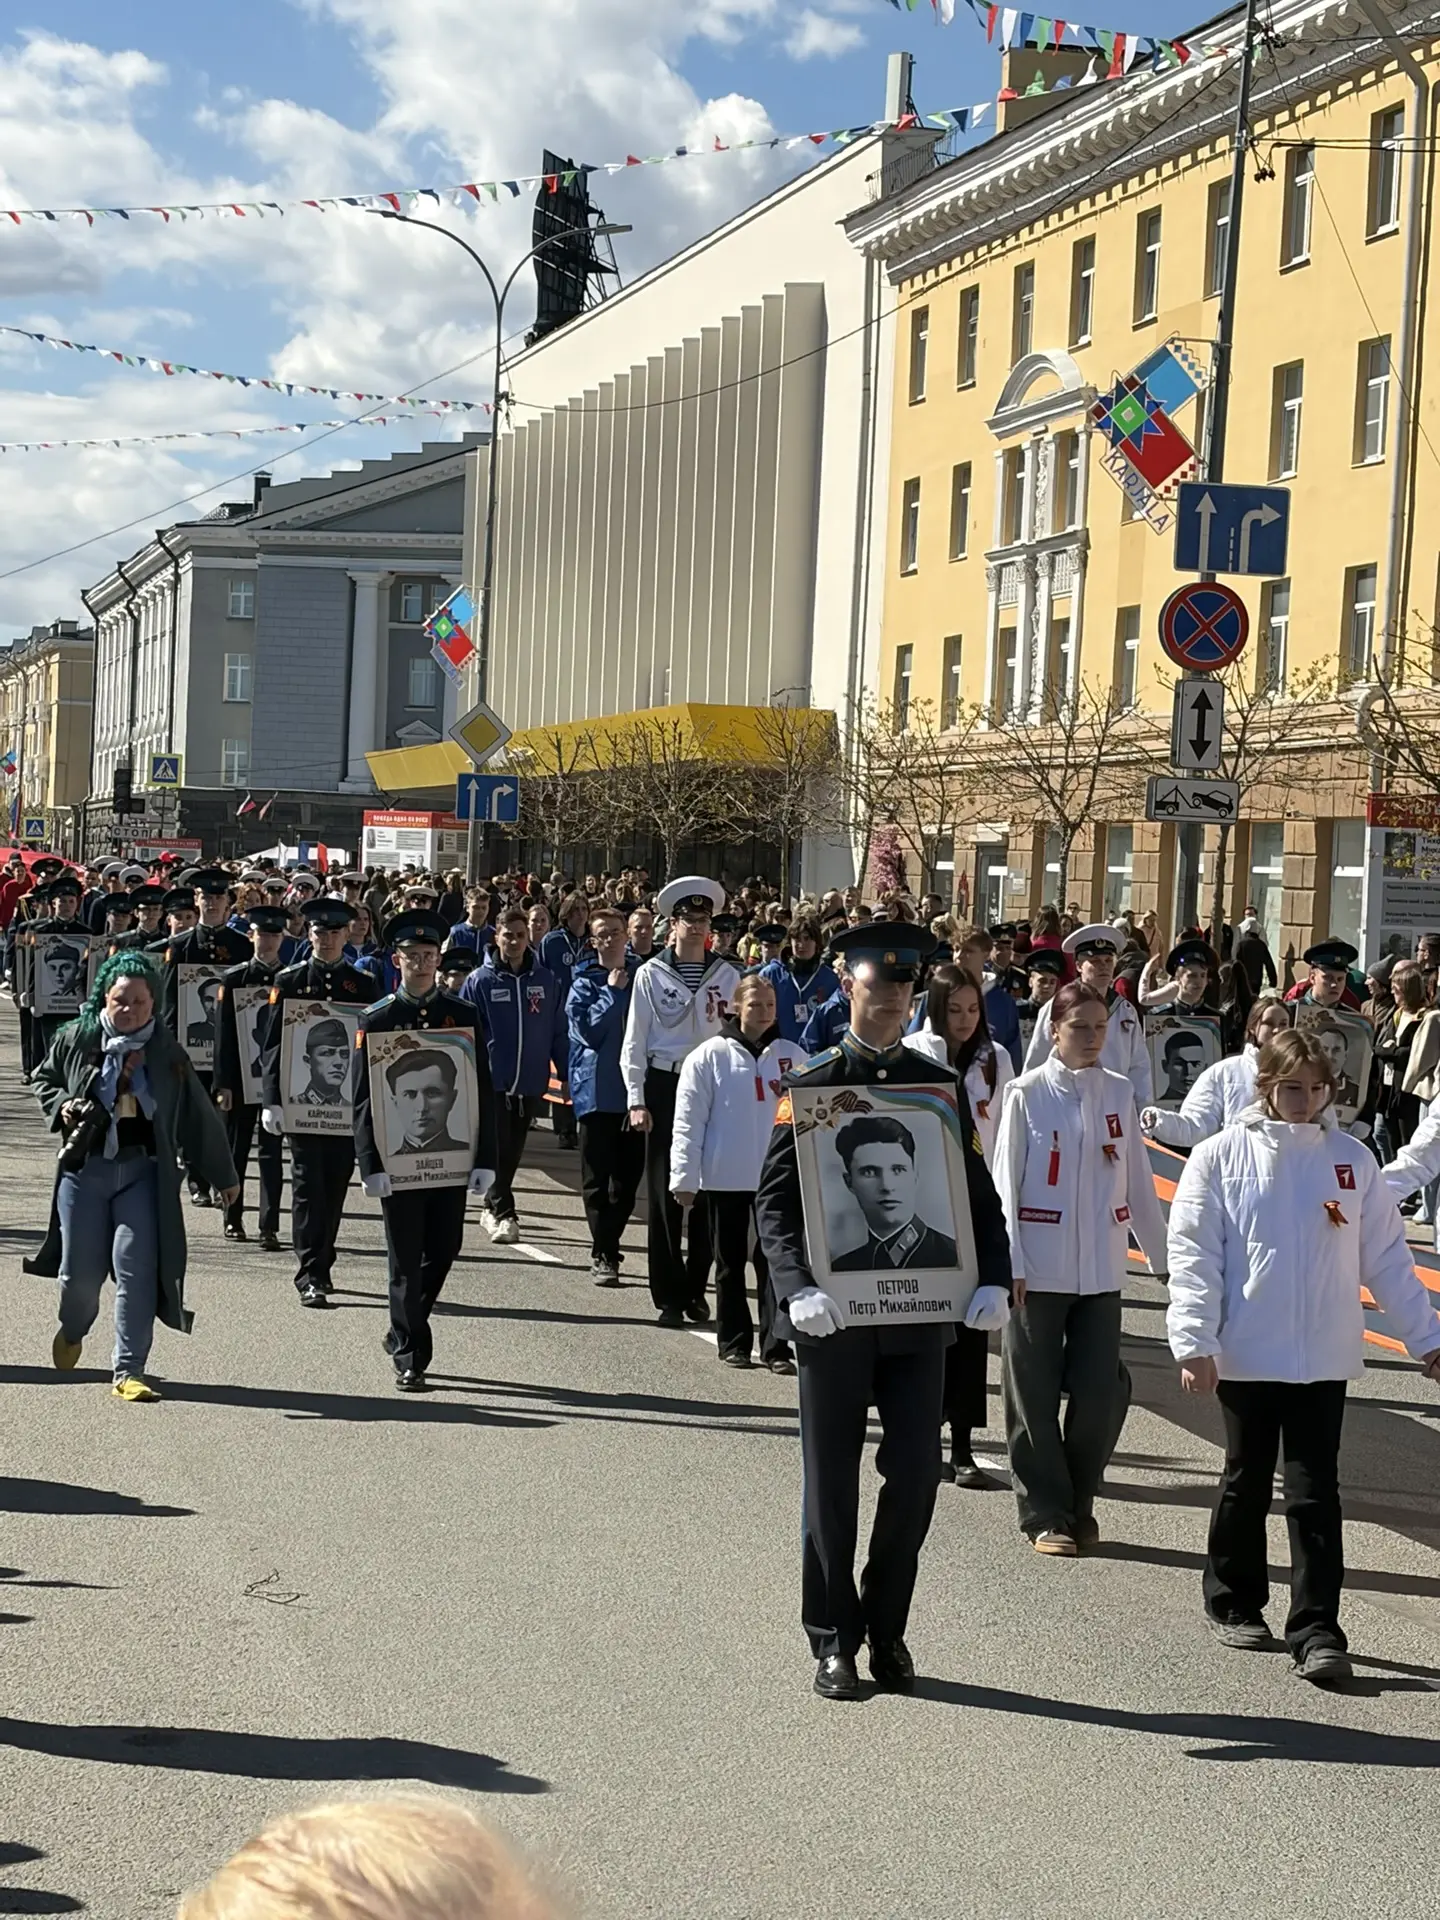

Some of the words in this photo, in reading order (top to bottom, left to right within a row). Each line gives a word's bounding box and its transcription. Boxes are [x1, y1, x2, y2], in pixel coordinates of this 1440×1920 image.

[1104, 451, 1169, 531] KARJALA
[114, 827, 148, 837] СТОП
[415, 1157, 444, 1170] ЗАЙЦЕВ
[877, 1278, 919, 1295] ПЕТРОВ
[848, 1300, 877, 1317] Петр
[879, 1297, 952, 1314] Михайлович
